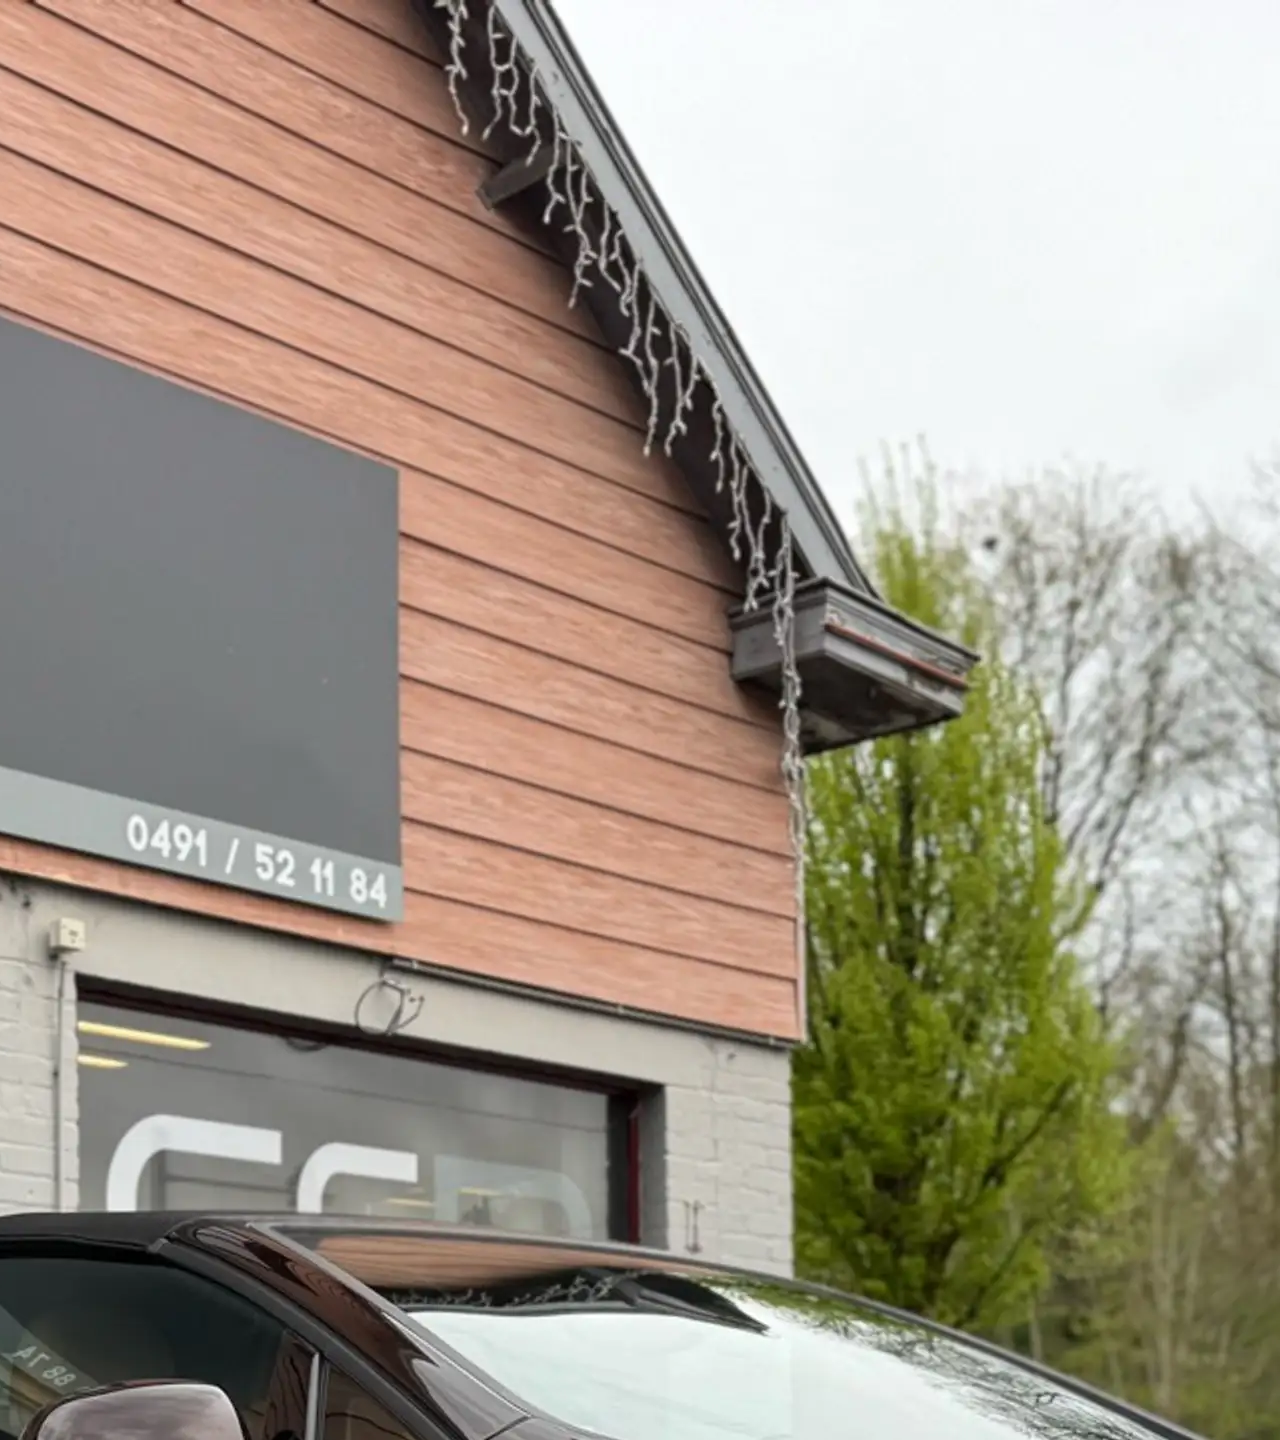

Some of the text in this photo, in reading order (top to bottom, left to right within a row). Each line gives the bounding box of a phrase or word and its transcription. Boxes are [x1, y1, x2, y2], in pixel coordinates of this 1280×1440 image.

[126, 814, 387, 909] 0491 / 52 11 84
